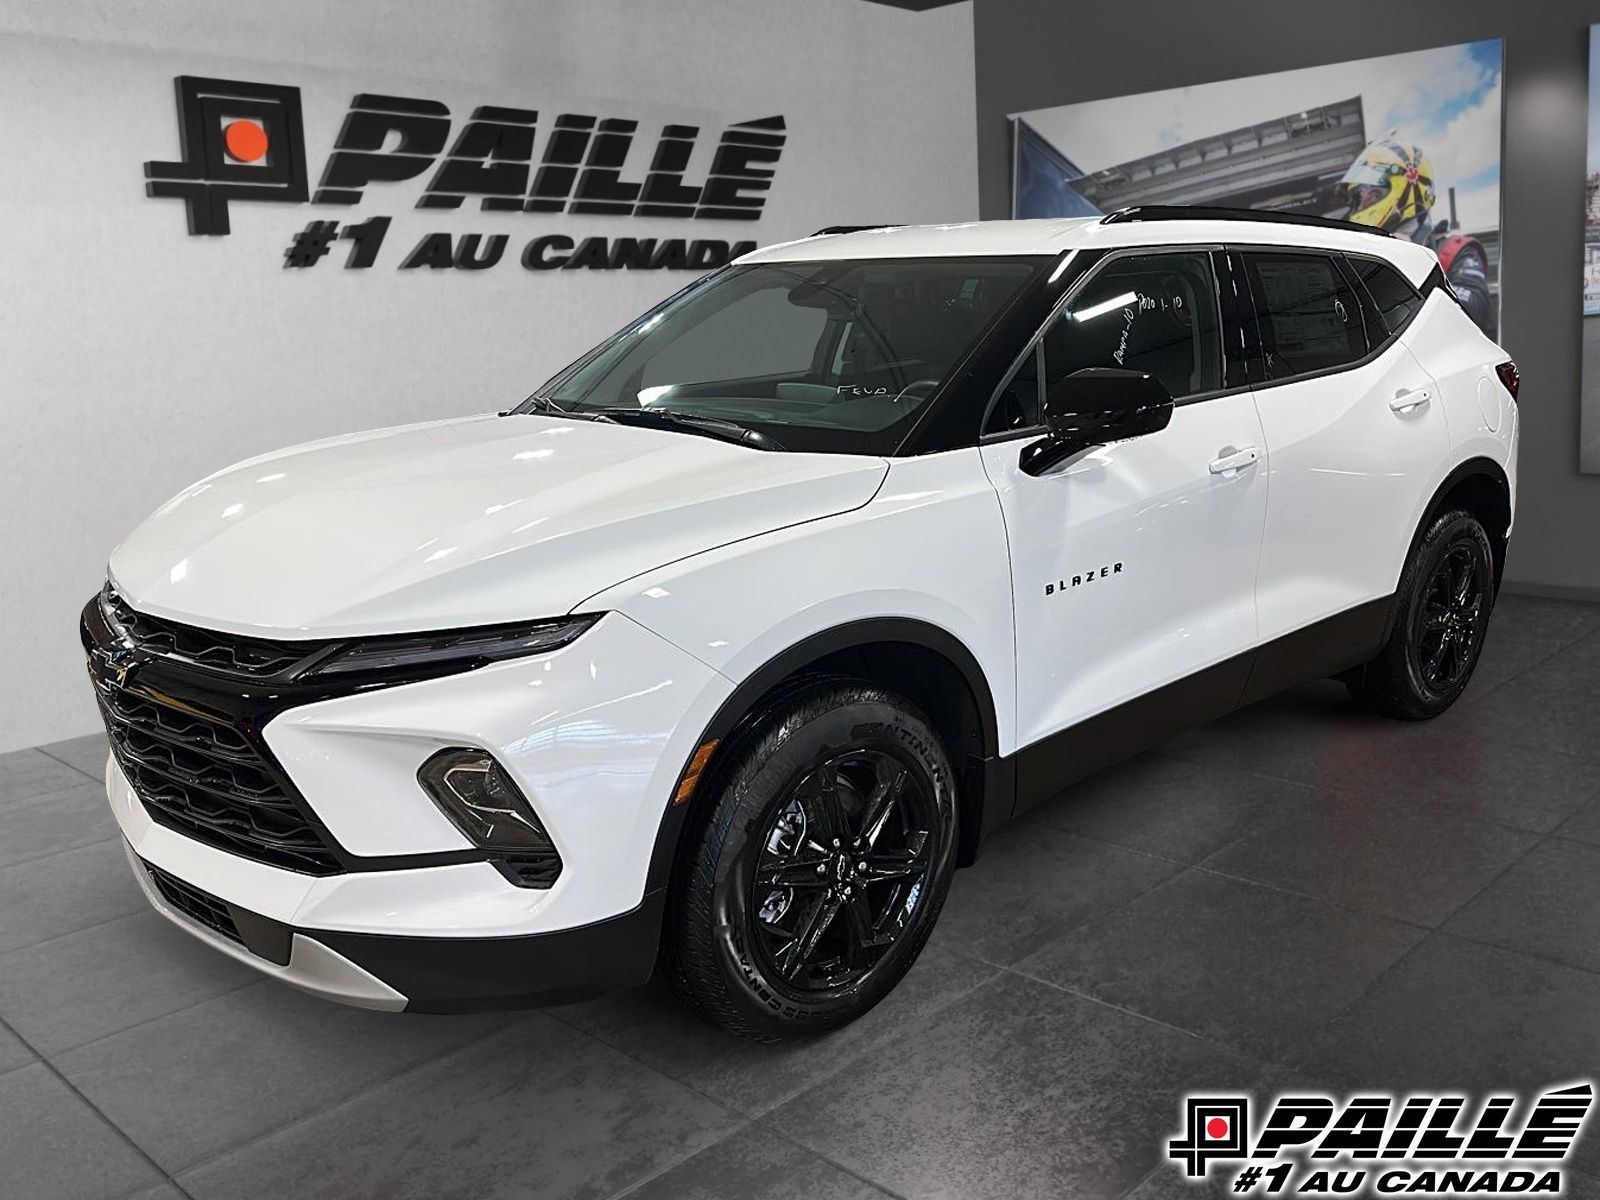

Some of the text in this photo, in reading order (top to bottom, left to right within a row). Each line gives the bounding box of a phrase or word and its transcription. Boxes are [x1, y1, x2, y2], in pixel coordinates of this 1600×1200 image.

[310, 93, 787, 220] PAILLÉ
[283, 216, 392, 269] #1
[397, 233, 510, 270] AU
[1045, 562, 1122, 596] BLAZER
